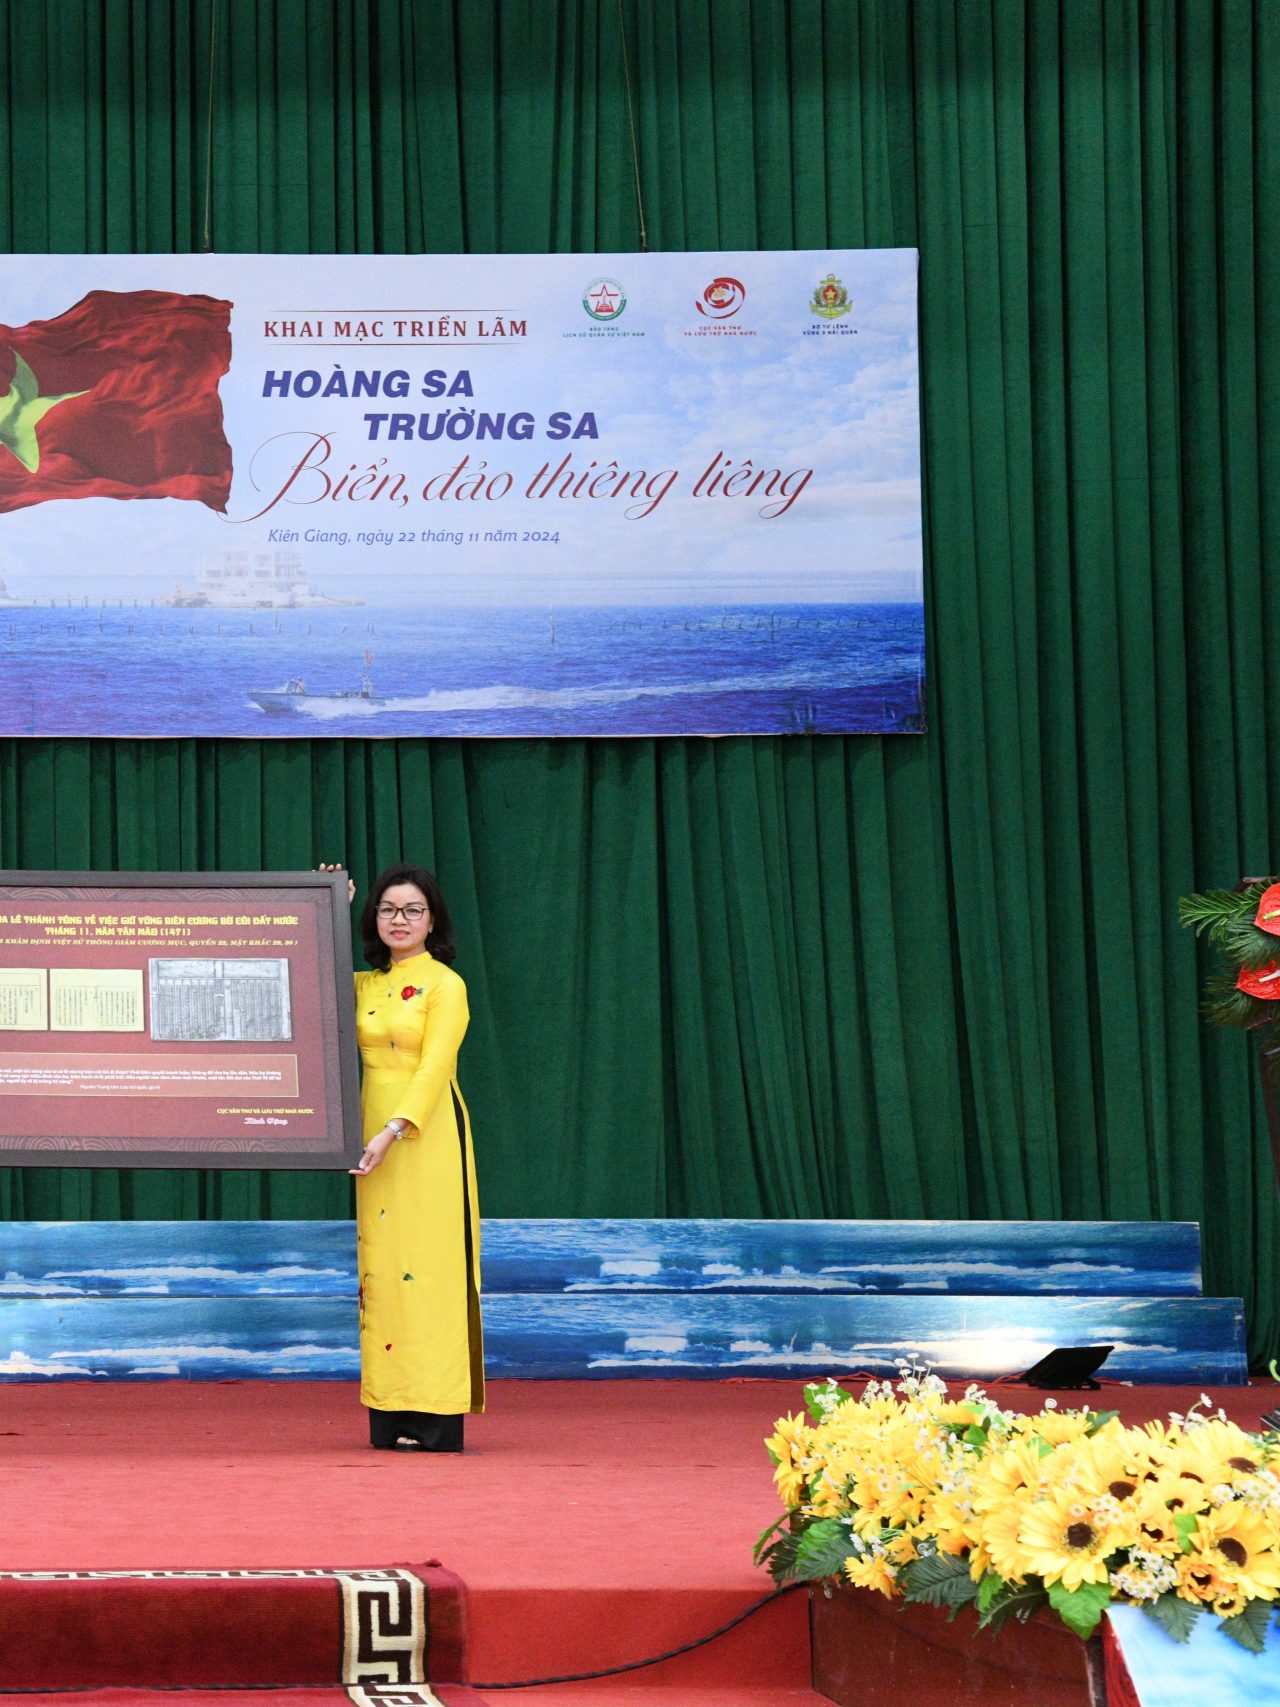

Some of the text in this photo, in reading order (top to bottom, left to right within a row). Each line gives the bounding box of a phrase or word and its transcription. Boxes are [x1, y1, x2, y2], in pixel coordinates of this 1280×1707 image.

[263, 315, 528, 341] KHAI MẠC TRIỂN LÃM
[262, 364, 474, 398] HOÀNG SA
[363, 407, 600, 441] TRƯỜNG SA
[216, 431, 814, 524] Biển, đảo thiêng liêng
[268, 529, 561, 546] Kiên Giang, ngày 22 tháng 11 năm 2024
